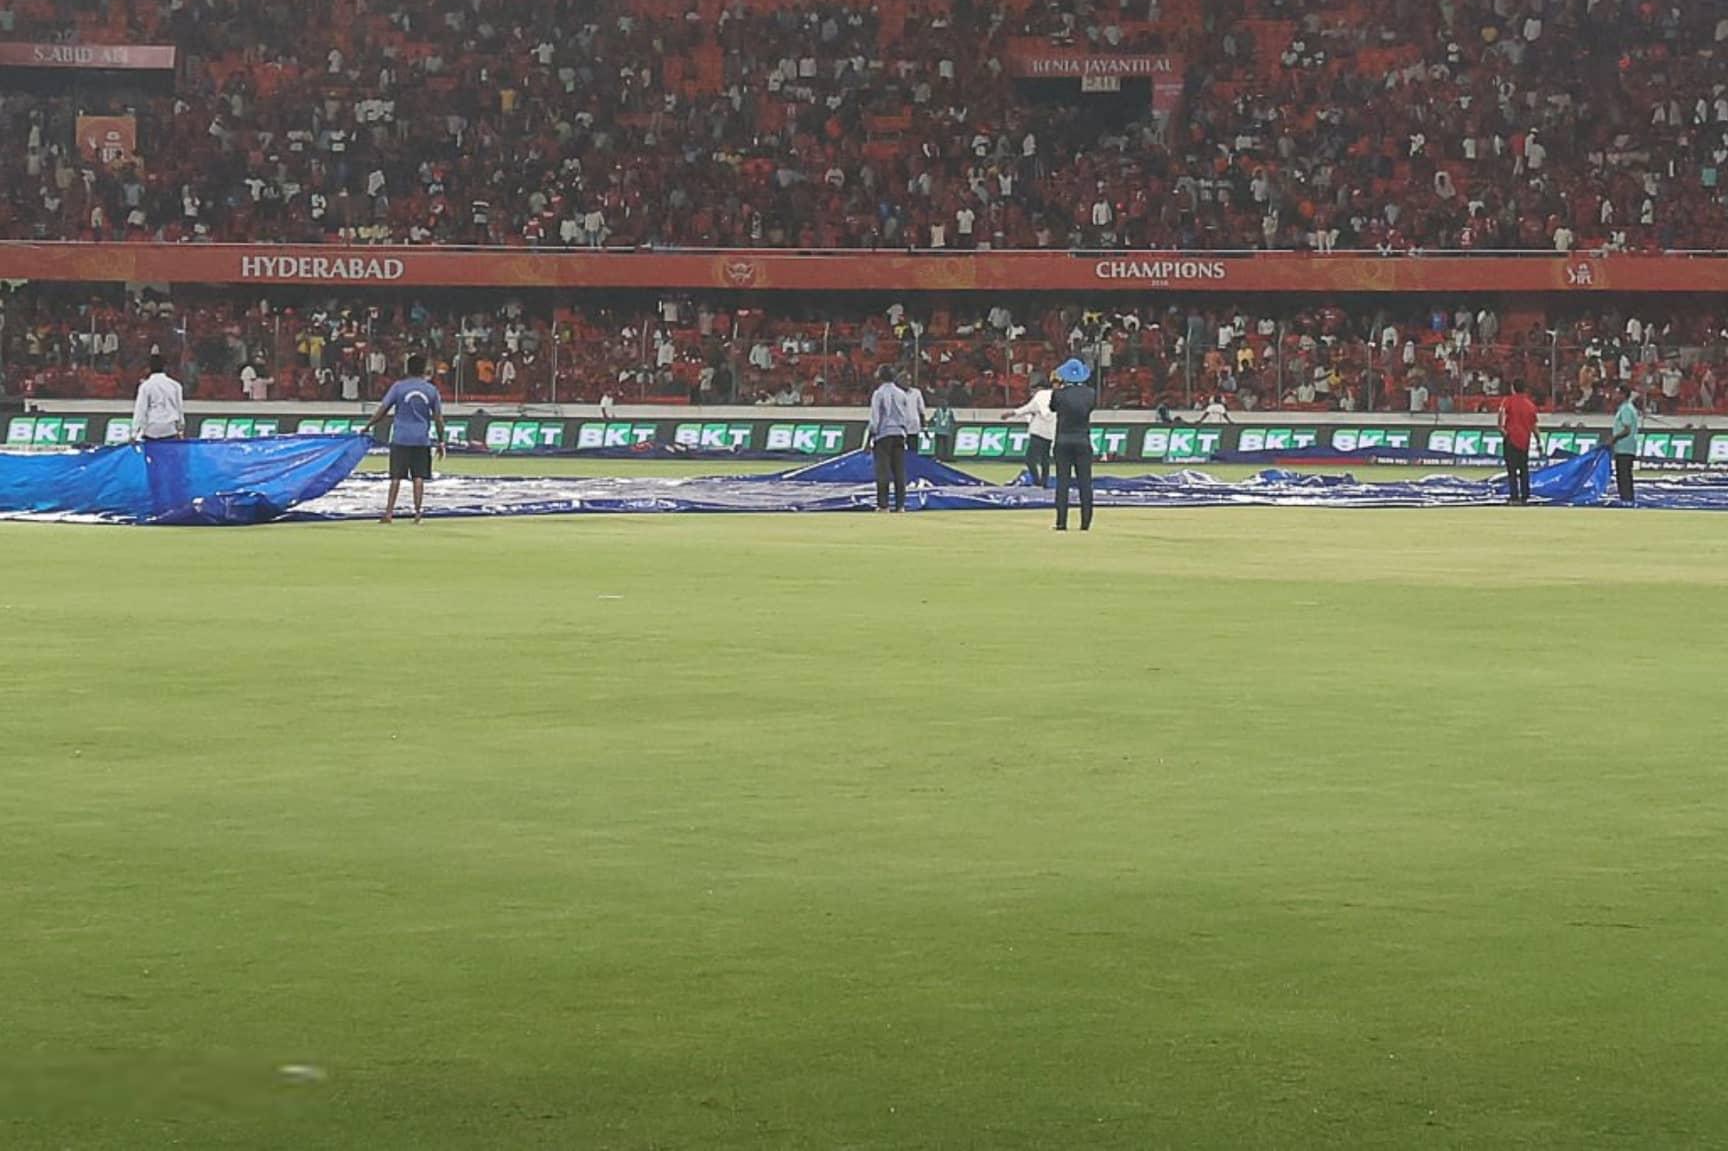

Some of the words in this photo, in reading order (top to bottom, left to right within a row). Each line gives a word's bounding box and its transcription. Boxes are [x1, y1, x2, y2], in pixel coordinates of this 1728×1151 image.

[242, 256, 404, 279] HYDERABAD
[1096, 261, 1226, 278] CHAMPIONS
[8, 422, 85, 443] BKT
[201, 424, 277, 439] BKT
[486, 424, 562, 445] BKT
[579, 428, 655, 449] BKT
[676, 429, 751, 450] BKT
[766, 429, 844, 450] BKT
[956, 432, 1030, 452] BKT
[1144, 433, 1220, 453] BKT
[1238, 434, 1315, 452] BKT
[1331, 434, 1408, 451] BKT
[1429, 436, 1502, 456] BKT
